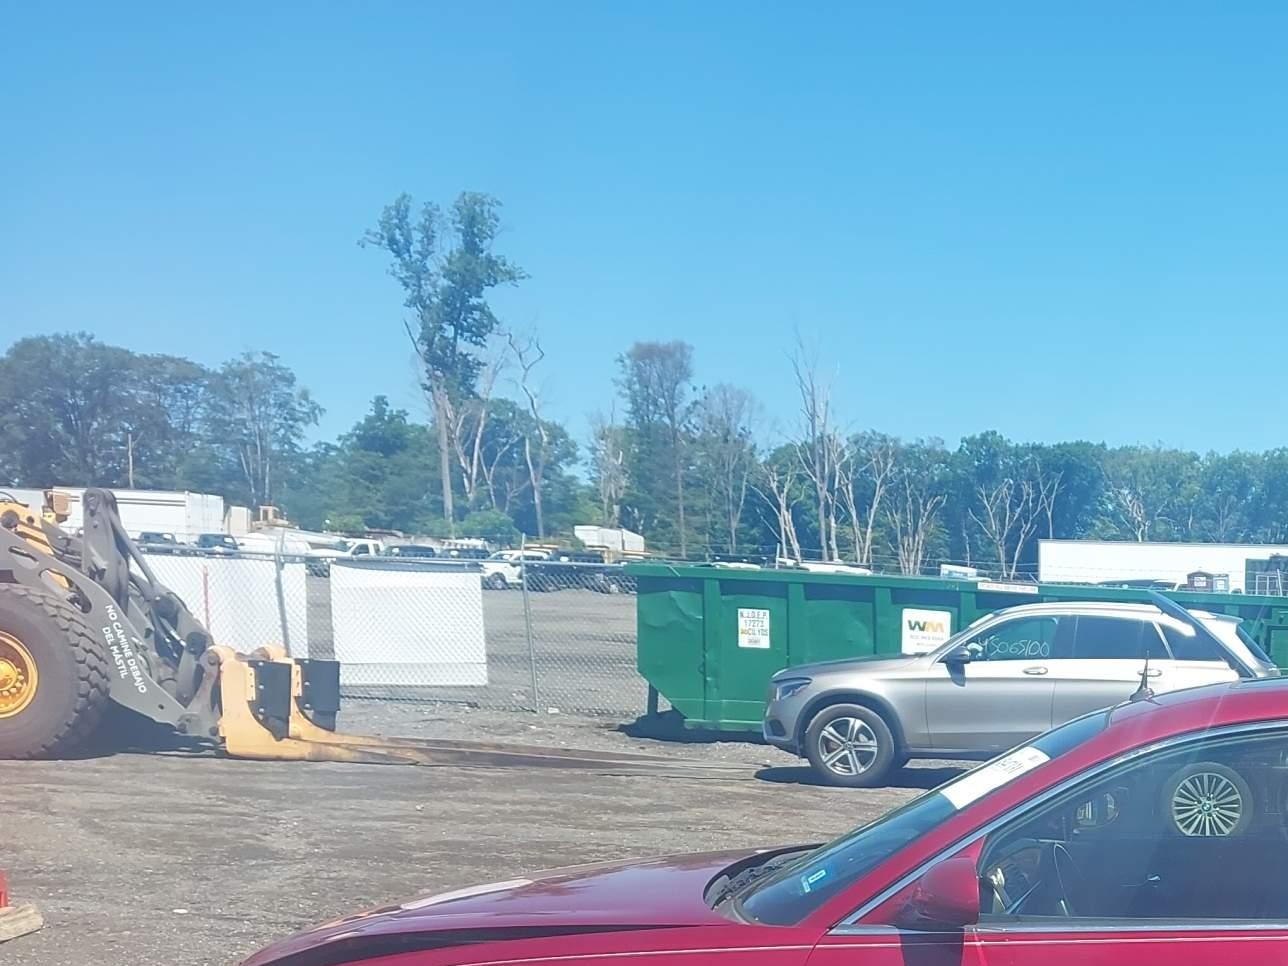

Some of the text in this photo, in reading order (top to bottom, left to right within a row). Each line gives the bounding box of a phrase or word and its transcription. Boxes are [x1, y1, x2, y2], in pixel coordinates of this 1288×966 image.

[907, 619, 945, 632] WM
[102, 626, 115, 646] DEL
[105, 604, 147, 694] NO CAMINE DEBAJO
